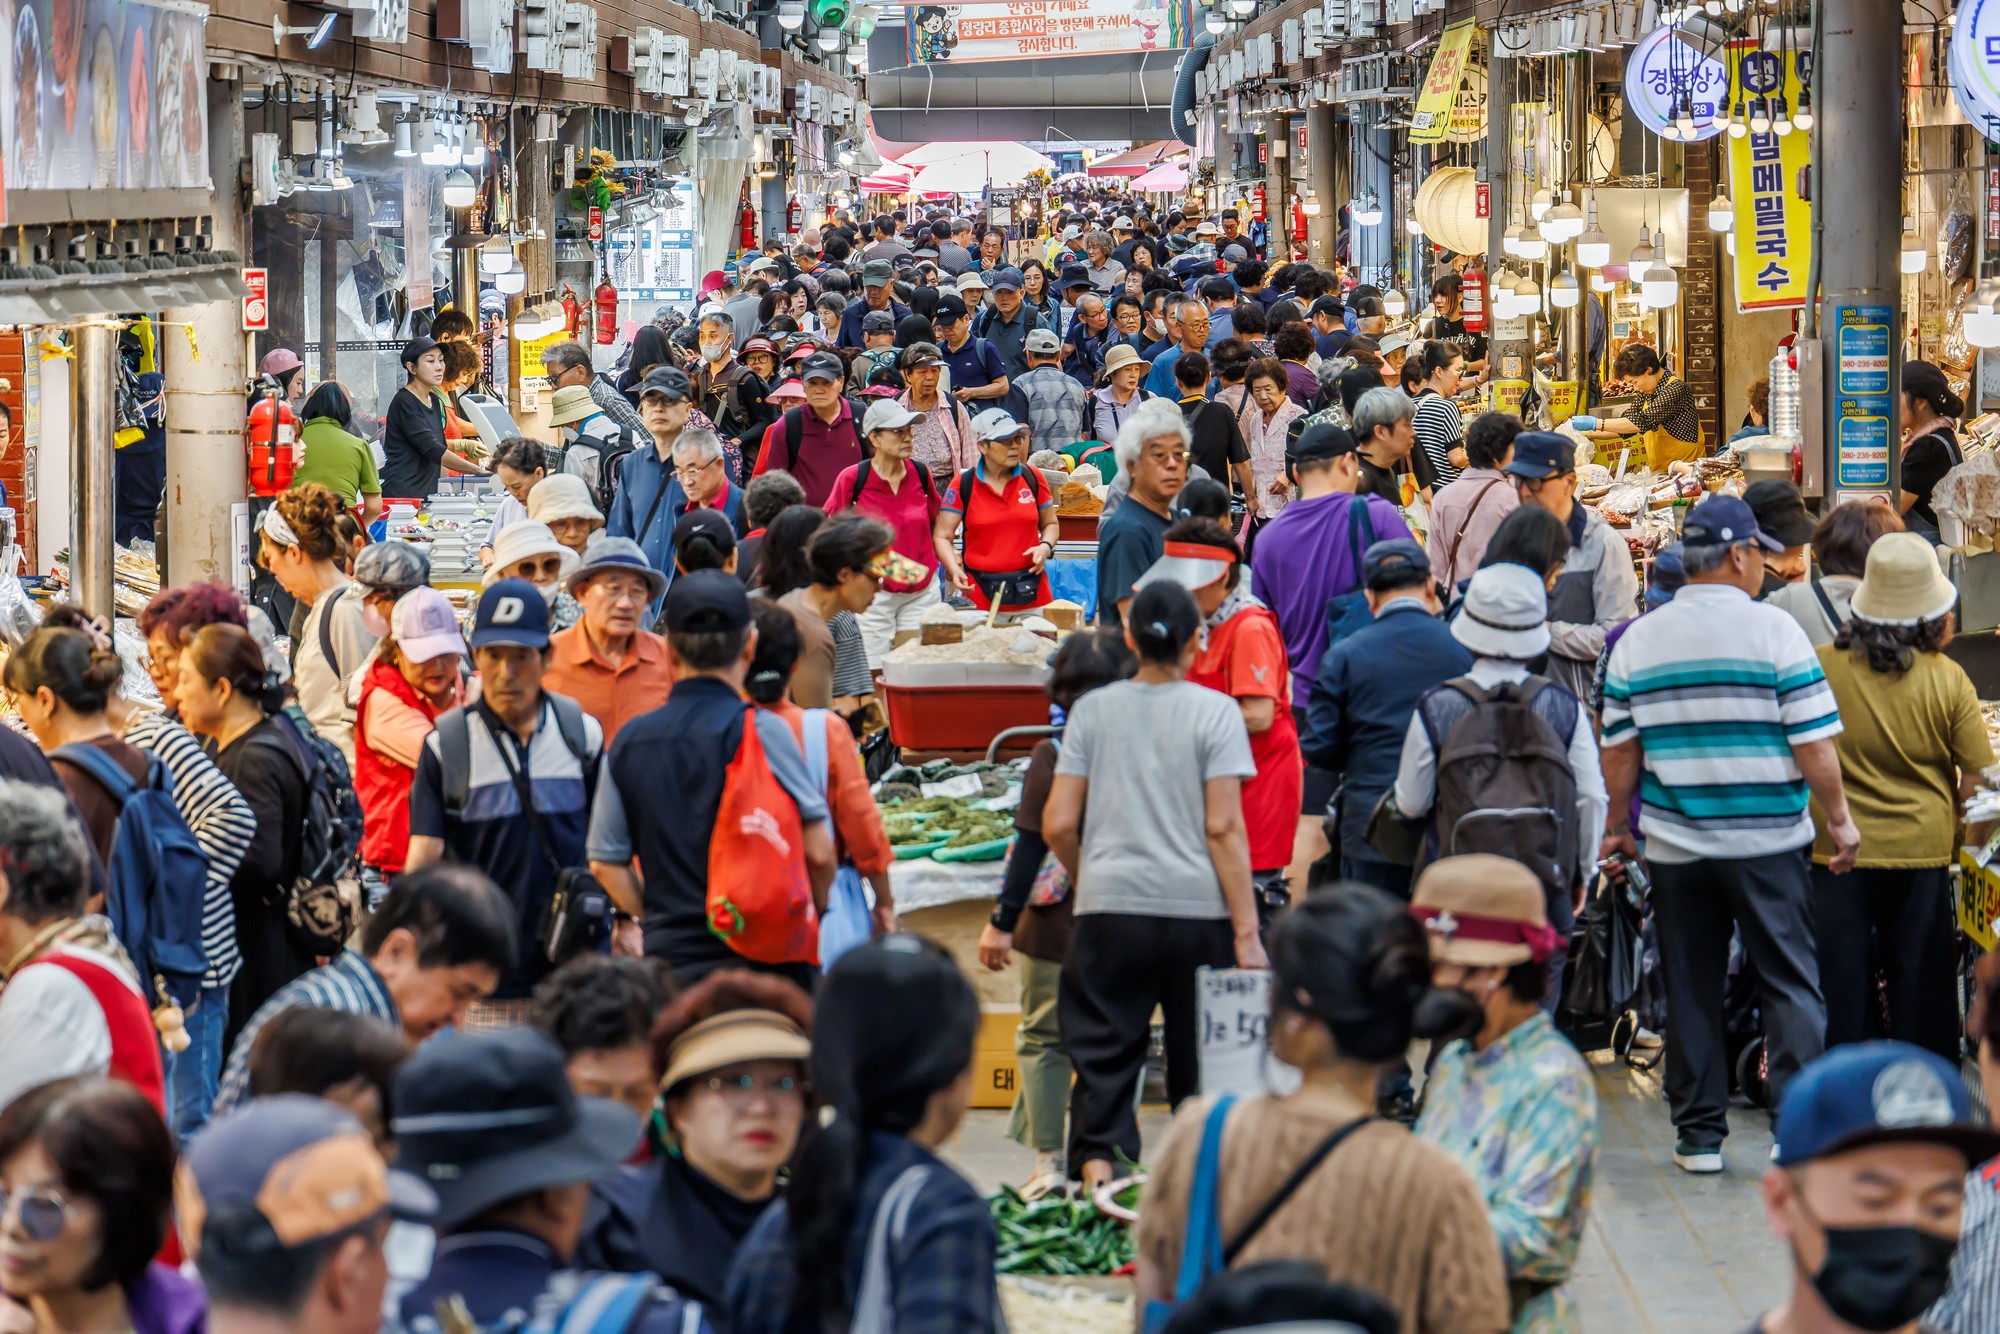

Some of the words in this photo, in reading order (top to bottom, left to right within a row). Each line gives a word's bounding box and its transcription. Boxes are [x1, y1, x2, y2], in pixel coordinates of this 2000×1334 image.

[960, 20, 996, 37] 청량리
[998, 16, 1058, 34] 종합시장을
[1060, 16, 1095, 32] 방문해
[1096, 14, 1131, 29] 주셔서
[1016, 37, 1078, 53] 감사합니다.
[492, 597, 524, 624] D
